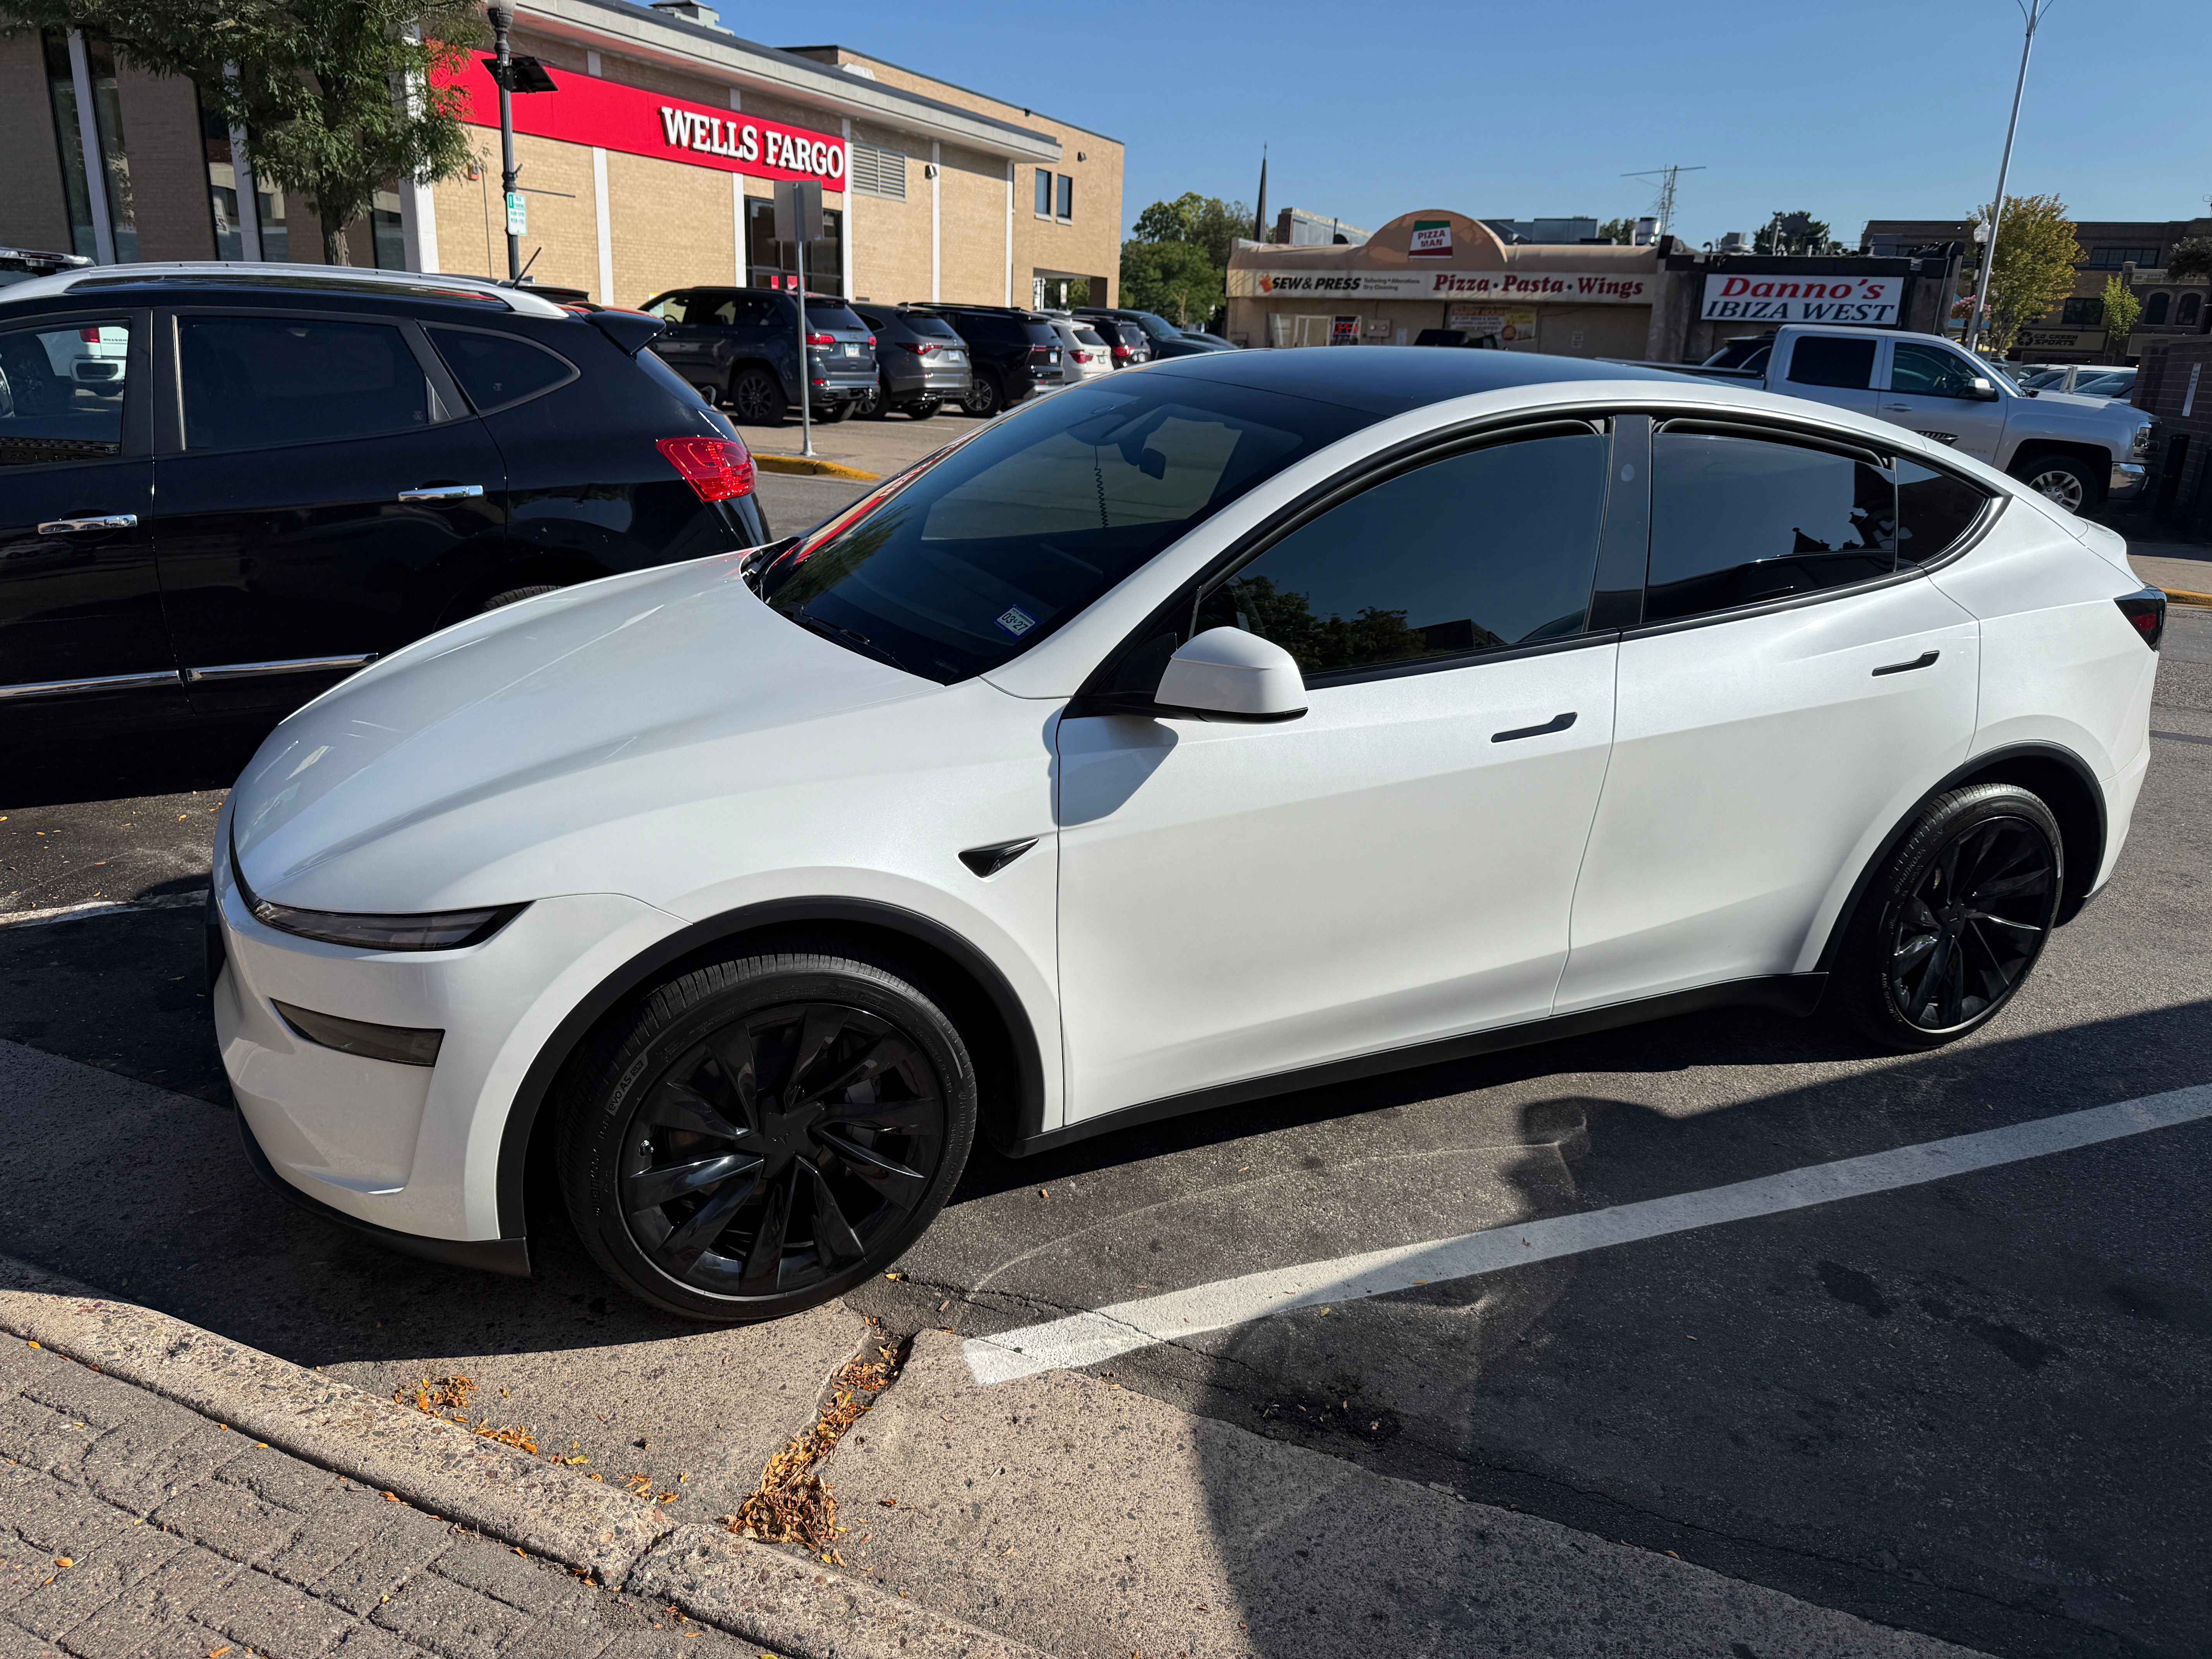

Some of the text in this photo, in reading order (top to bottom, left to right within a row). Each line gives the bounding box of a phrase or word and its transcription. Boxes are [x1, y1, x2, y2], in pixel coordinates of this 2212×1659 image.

[660, 106, 844, 178] WELLS FARGO
[1418, 230, 1446, 239] PIZZA
[1420, 239, 1443, 247] MAN
[1272, 277, 1362, 290] SEW & PRESS
[1433, 274, 1644, 299] Pizza Pasta Wings
[1719, 277, 1885, 300] Danno's
[1705, 300, 1895, 321] IBIZA WEST
[1334, 322, 1360, 334] OPEN
[1002, 613, 1016, 623] 03
[1013, 621, 1029, 631] 27
[609, 1091, 622, 1111] evo
[620, 1075, 632, 1092] AS
